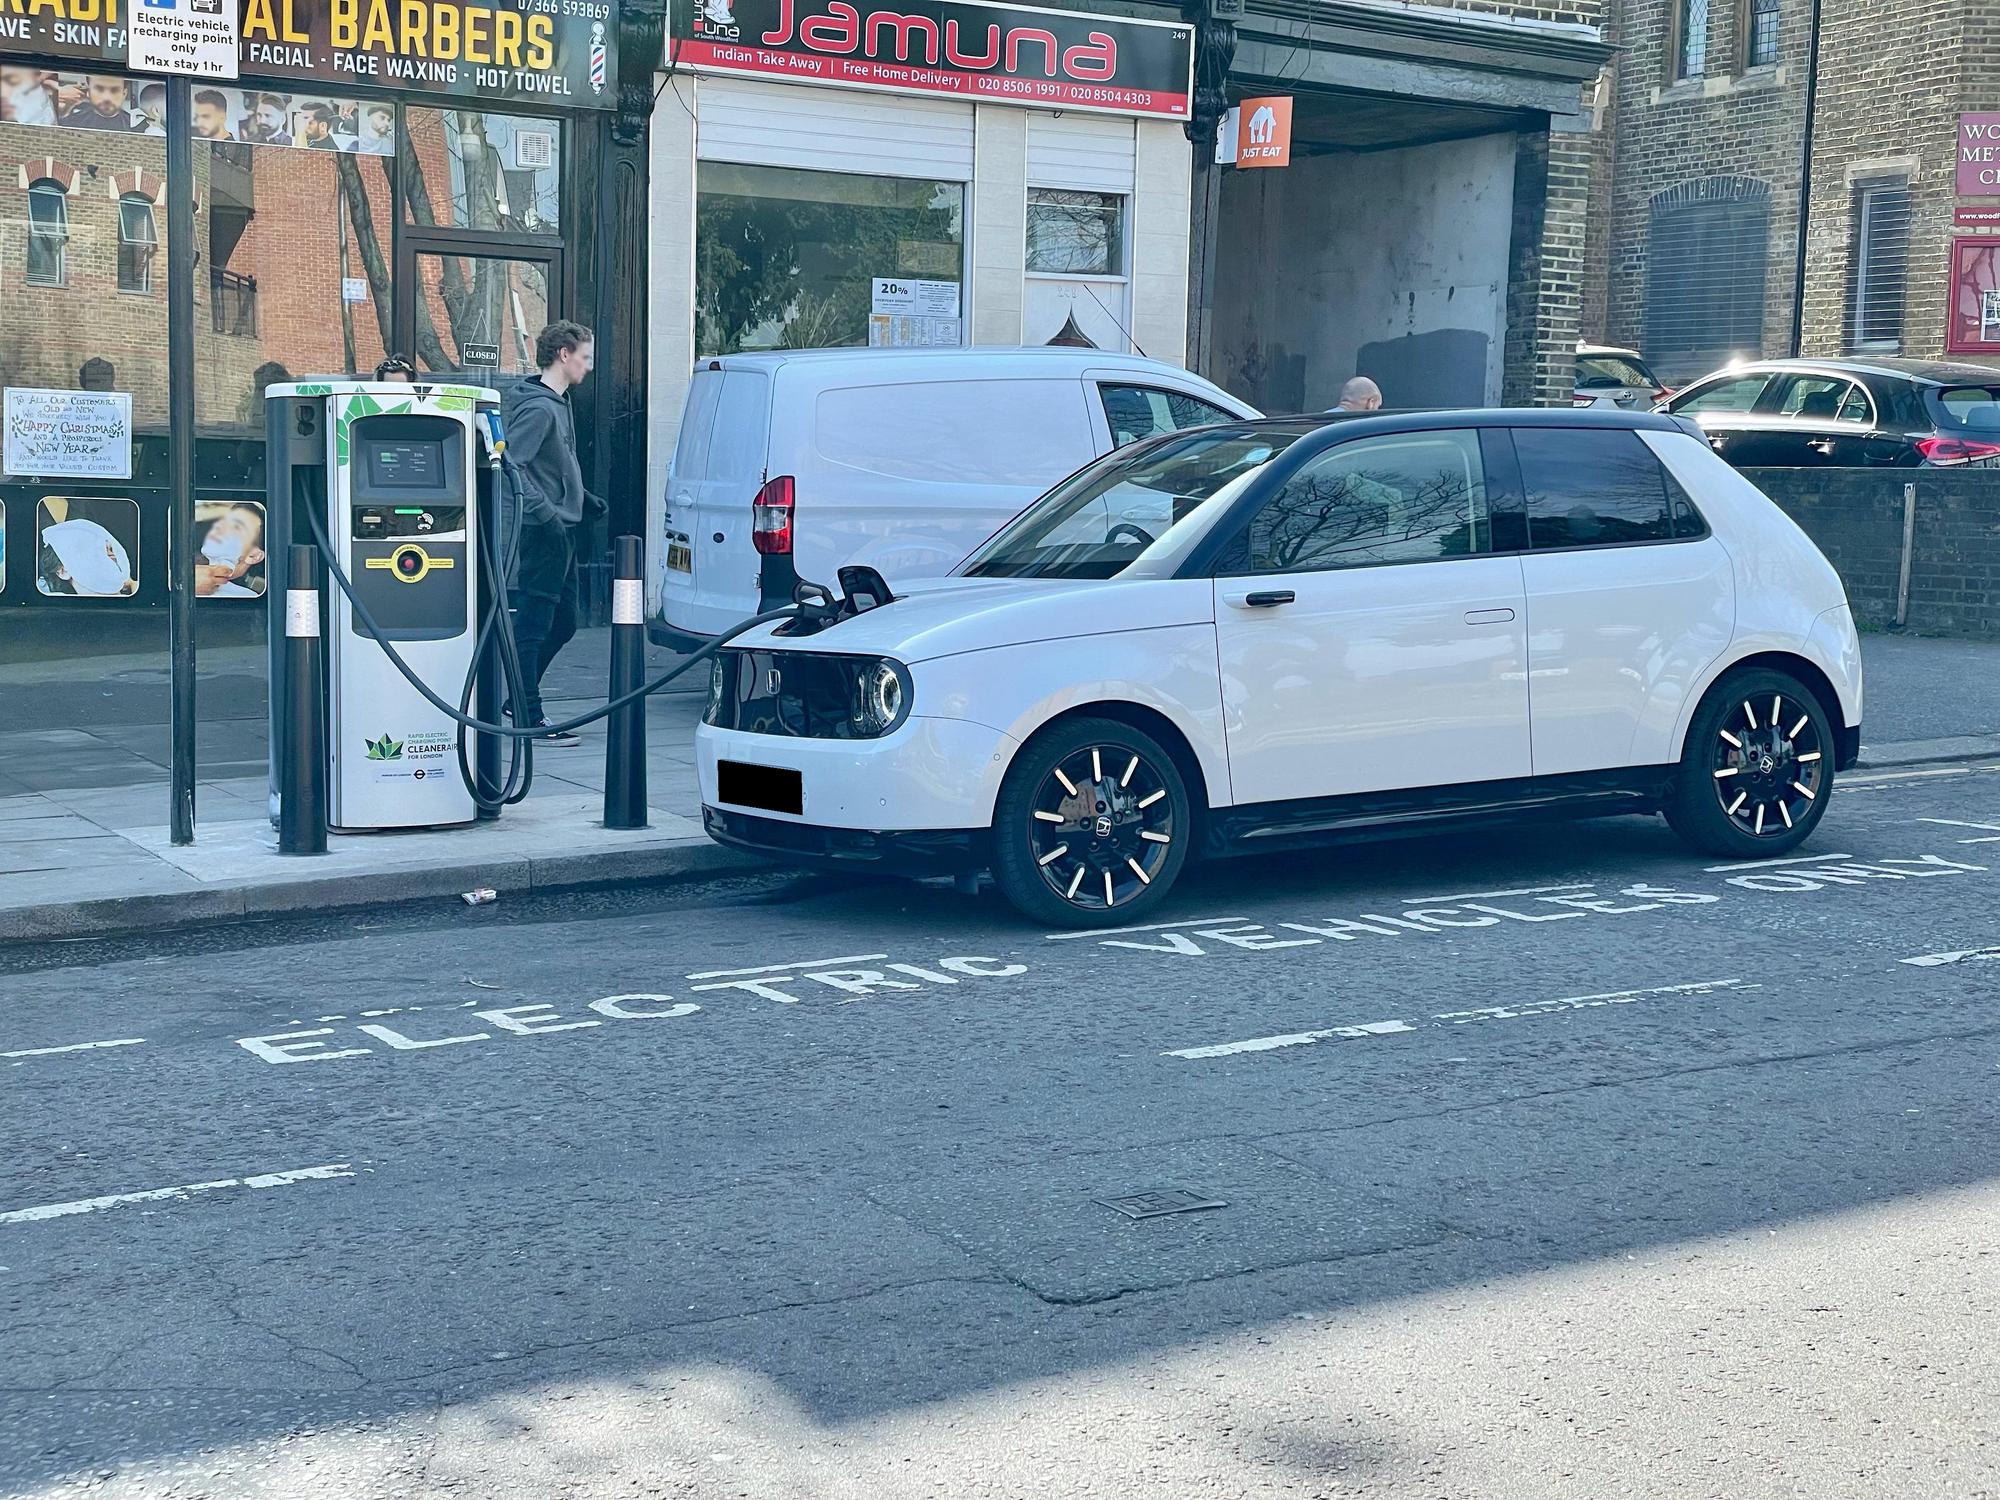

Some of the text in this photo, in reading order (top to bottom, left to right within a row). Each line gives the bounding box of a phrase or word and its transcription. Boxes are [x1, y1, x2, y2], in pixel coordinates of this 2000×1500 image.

[562, 1, 610, 20] 593869
[137, 12, 230, 32] Electric vehicle
[134, 27, 233, 45] recharging point
[330, 0, 553, 70] BARBERS
[762, 0, 1117, 82] Jamuna
[1172, 31, 1187, 40] 249
[171, 43, 197, 55] only
[54, 22, 100, 47] SKIN
[250, 42, 314, 68] FACIAL
[333, 52, 379, 75] FACE
[386, 57, 457, 84] WAXING
[476, 67, 508, 88] HOT
[514, 71, 572, 95] TOWEL
[145, 55, 169, 67] Max
[174, 58, 199, 71] stay
[713, 46, 1151, 105] Indian Take Away Free Home Delivery 020 8506 1991 020 8504 4303
[1241, 146, 1282, 160] JUST EAT
[881, 283, 908, 295] 20%
[466, 351, 497, 360] CLOSED
[23, 420, 114, 434] HAPPY CHRISTMAS
[36, 442, 89, 453] NEW YEAR
[235, 854, 1988, 1064] ELECTRIC VEHICLES ONLY
